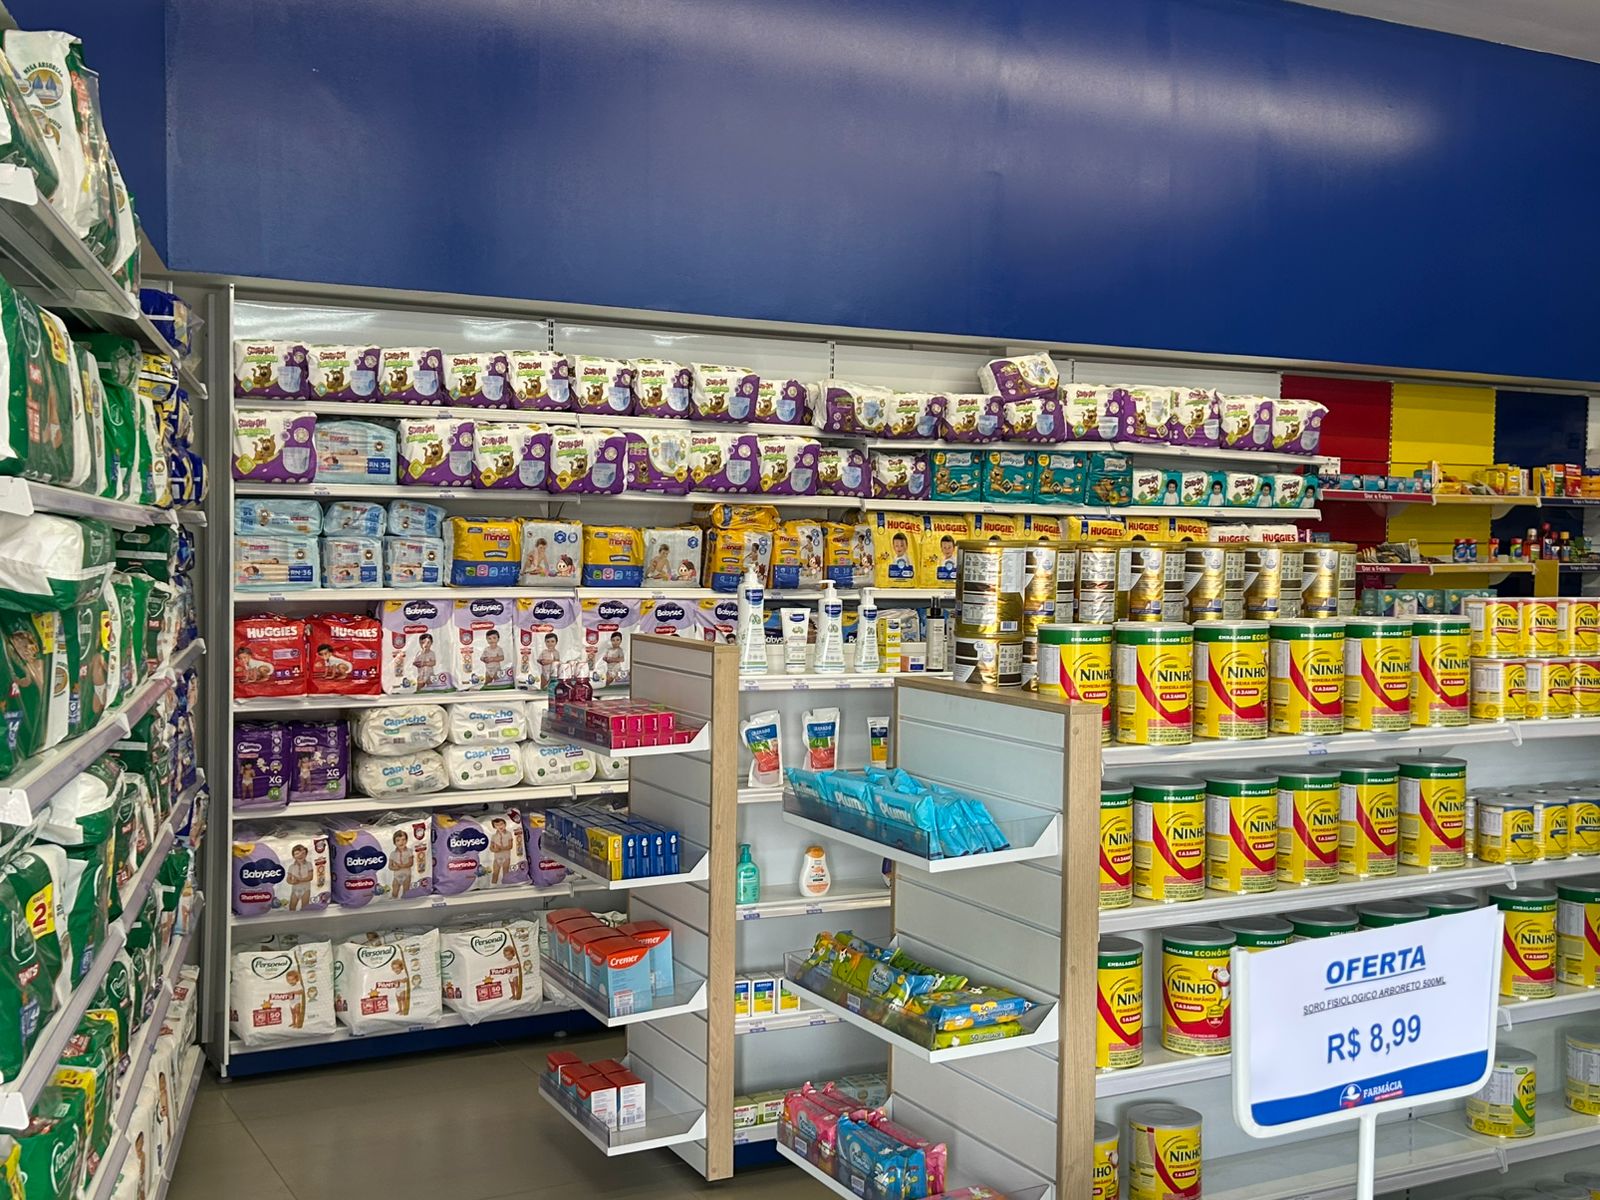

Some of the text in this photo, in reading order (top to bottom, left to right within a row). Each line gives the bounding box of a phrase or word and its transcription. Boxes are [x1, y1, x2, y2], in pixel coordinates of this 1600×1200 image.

[887, 520, 922, 532] HUGGIES
[934, 522, 968, 533] HUGGIES
[1128, 522, 1159, 532] HUGGIES
[1178, 524, 1208, 534] HUGGIES
[1090, 528, 1122, 536] HUGGIES
[1262, 534, 1296, 542] HUGGIES
[405, 606, 437, 616] Babysec
[472, 604, 504, 612] Babysec
[535, 606, 562, 616] Babysec
[600, 606, 628, 615] Babysec
[657, 608, 684, 617] Babysec
[716, 608, 738, 616] Babyse
[246, 626, 298, 639] HUGGIES
[330, 626, 378, 638] HUGGIES
[1228, 666, 1266, 678] NINHO
[1514, 679, 1526, 687] NIN
[384, 714, 426, 726] Capricho
[469, 710, 513, 720] Capricho
[464, 746, 510, 760] Capricho
[326, 768, 340, 777] XG
[269, 775, 282, 784] XG
[1376, 806, 1398, 819] NINH
[1313, 813, 1340, 826] NINH
[1555, 820, 1568, 828] NIN
[1581, 815, 1600, 824] NINH
[1250, 820, 1278, 833] NINH
[450, 836, 486, 848] Babysec
[346, 856, 384, 867] Babysec
[242, 868, 282, 881] Babysec
[345, 879, 374, 888] Shortinho
[240, 893, 271, 902] Shortinho
[33, 903, 47, 928] 2
[474, 936, 505, 947] Personal
[1521, 934, 1556, 944] NINHO
[361, 948, 394, 959] Personal
[1194, 948, 1232, 958] ECONÔM
[254, 960, 290, 970] Personal
[610, 954, 639, 966] Cremer
[1326, 945, 1426, 984] OFERTA
[1171, 980, 1216, 994] NINHO
[1118, 993, 1143, 1006] NINH
[1304, 976, 1446, 1015] SORO FISIOLOGICO ARBORETO 500ML
[1327, 1015, 1421, 1064] R$ 8,99
[1364, 1081, 1402, 1098] FARMÁCIA
[1522, 1085, 1535, 1095] NIN
